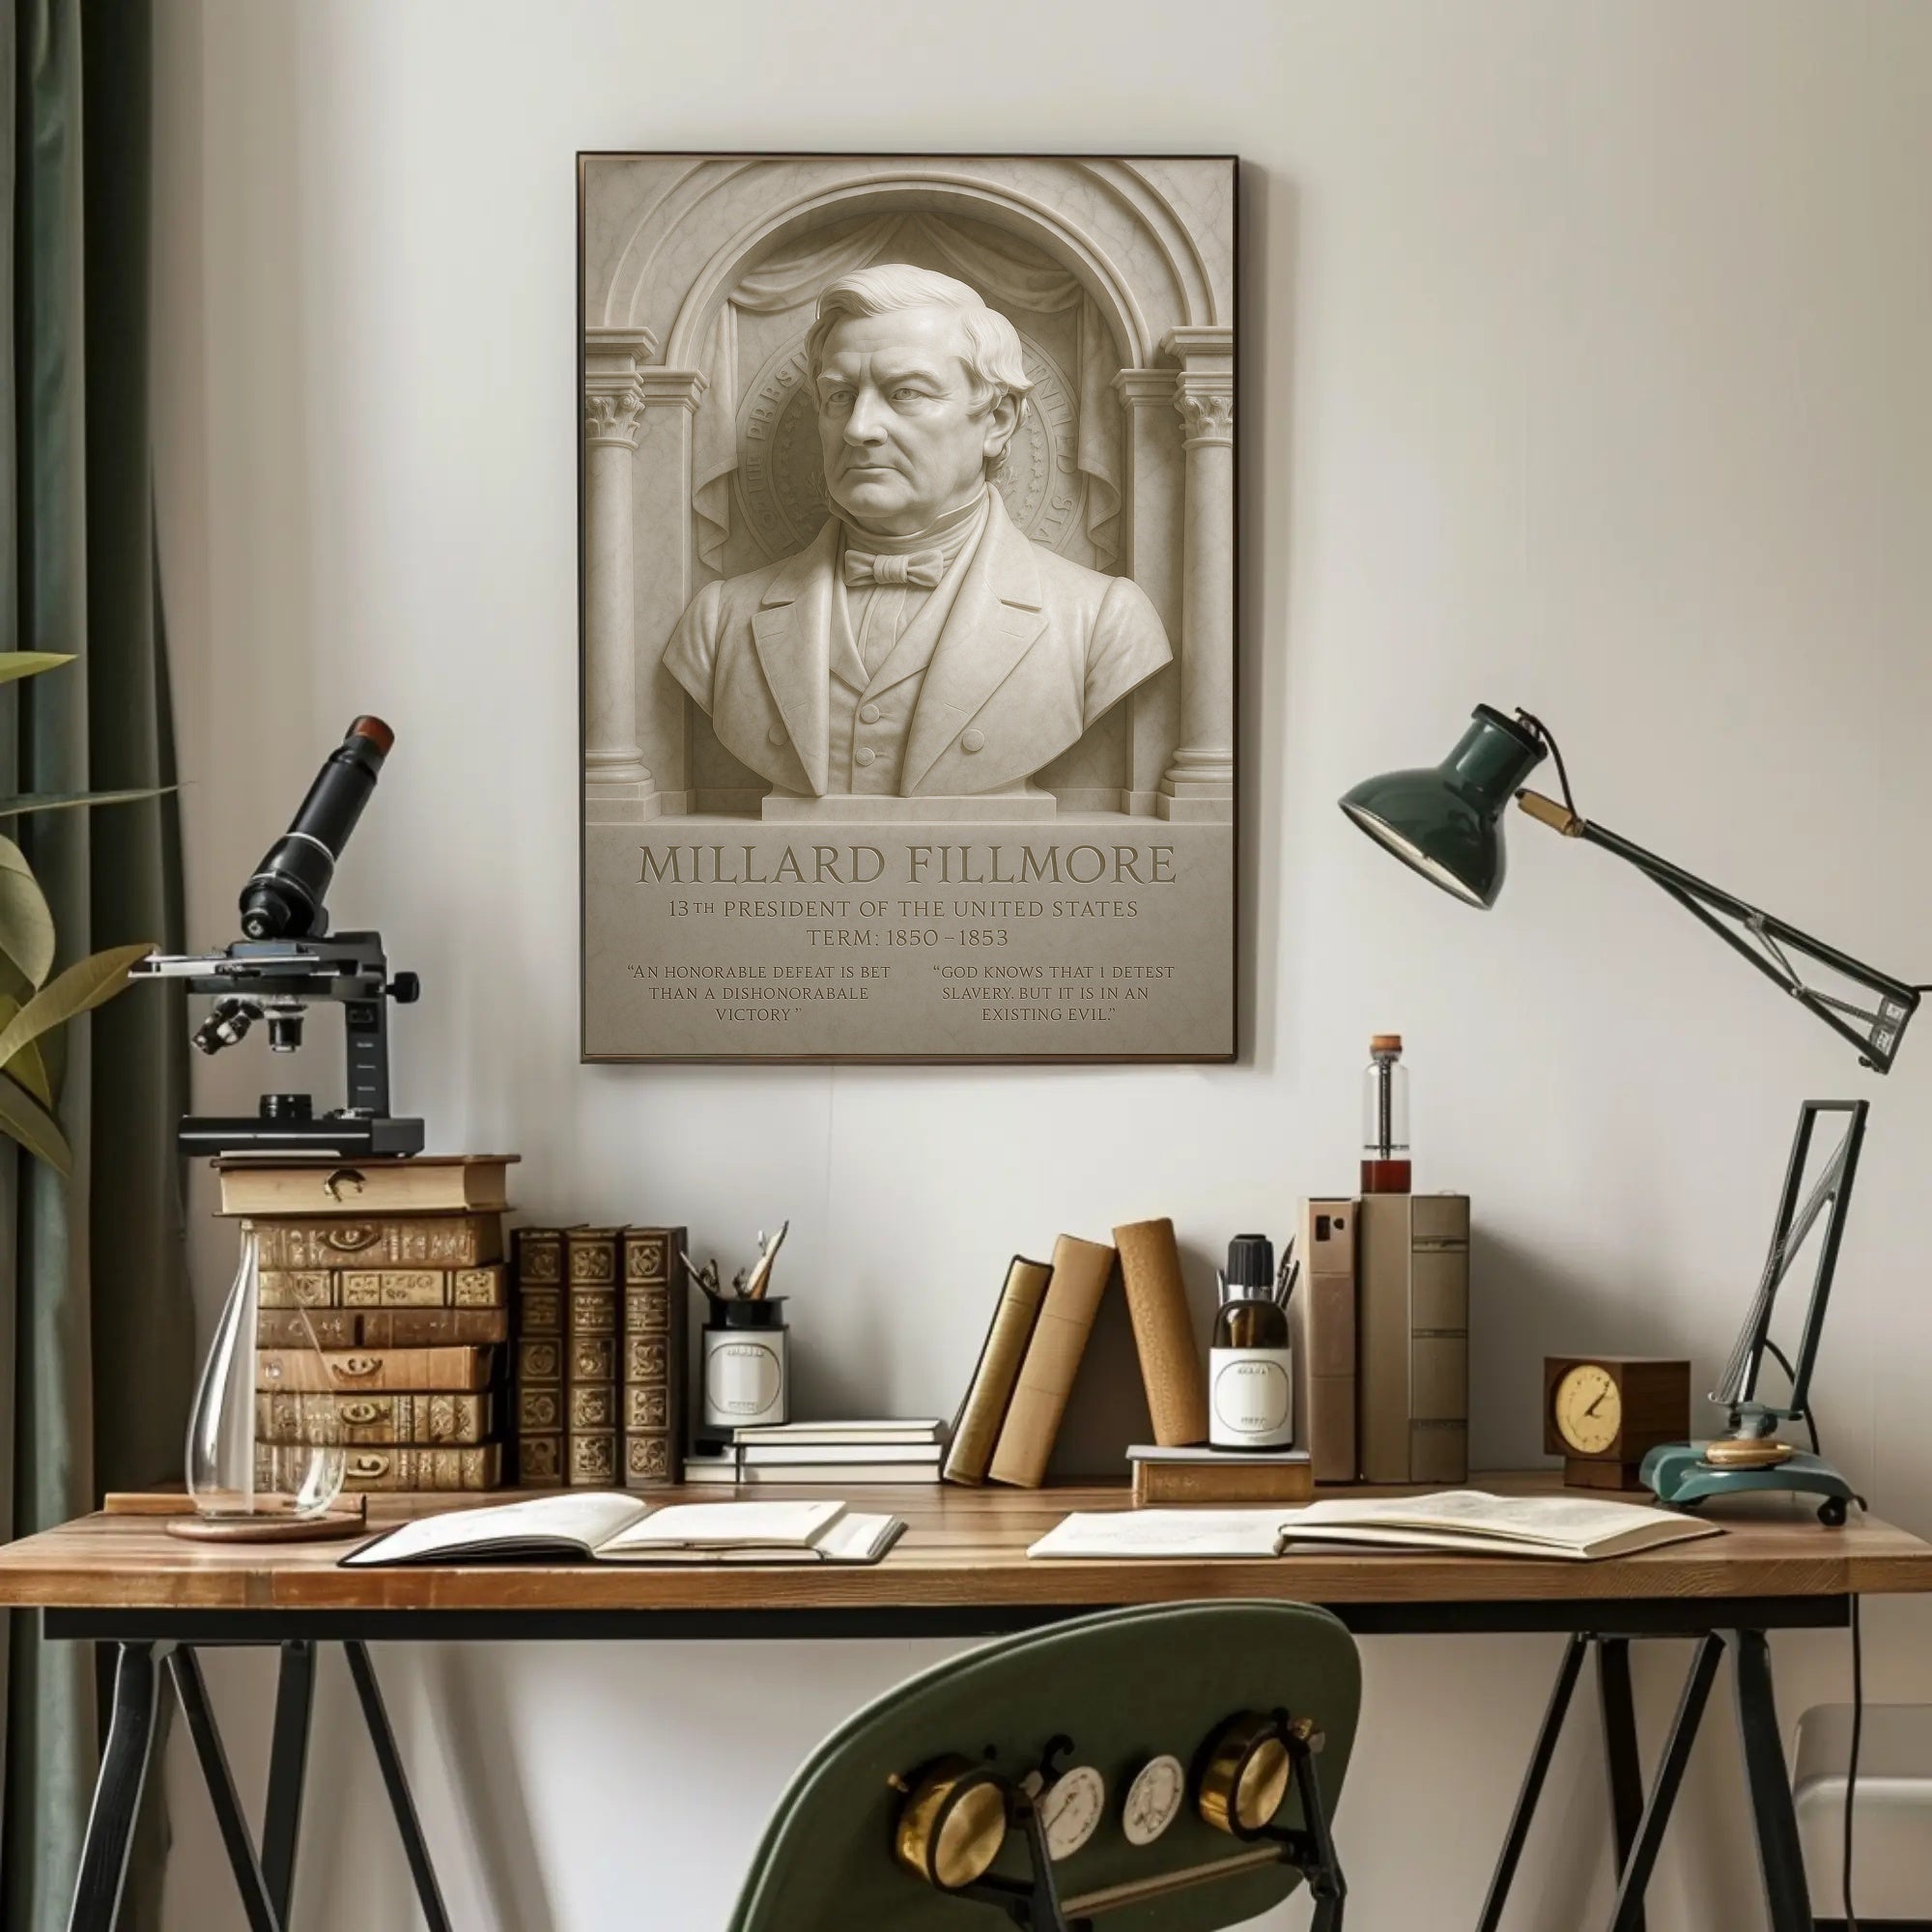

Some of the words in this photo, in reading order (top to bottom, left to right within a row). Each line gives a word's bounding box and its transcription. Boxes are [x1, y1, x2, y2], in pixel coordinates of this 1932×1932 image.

[635, 844, 886, 885] MILLARD
[904, 844, 1177, 885] FILLMORE
[724, 900, 851, 918] PRESIDENT
[858, 900, 889, 918] OF
[897, 900, 945, 918] THE
[953, 900, 1043, 918] UNITED
[1052, 900, 1138, 918] STATES
[806, 929, 879, 947] TERM:
[664, 966, 767, 980] HONORABLE
[772, 966, 836, 980] DEFEAT
[840, 966, 855, 980] IS
[860, 966, 891, 980] BET
[983, 966, 1044, 980] KNOWS
[1049, 966, 1094, 980] THAT
[1099, 966, 1106, 980] I
[1111, 966, 1176, 980] DETEST
[648, 986, 698, 1001] THAN
[704, 986, 717, 1001] A
[723, 986, 869, 1001] DISHONORABALE
[1018, 986, 1053, 1001] BUT
[1058, 986, 1075, 1001] IT
[1080, 986, 1094, 1001] IS
[1099, 986, 1119, 1001] IN
[1123, 986, 1150, 1001] AN
[980, 1008, 1063, 1022] EXISTING
